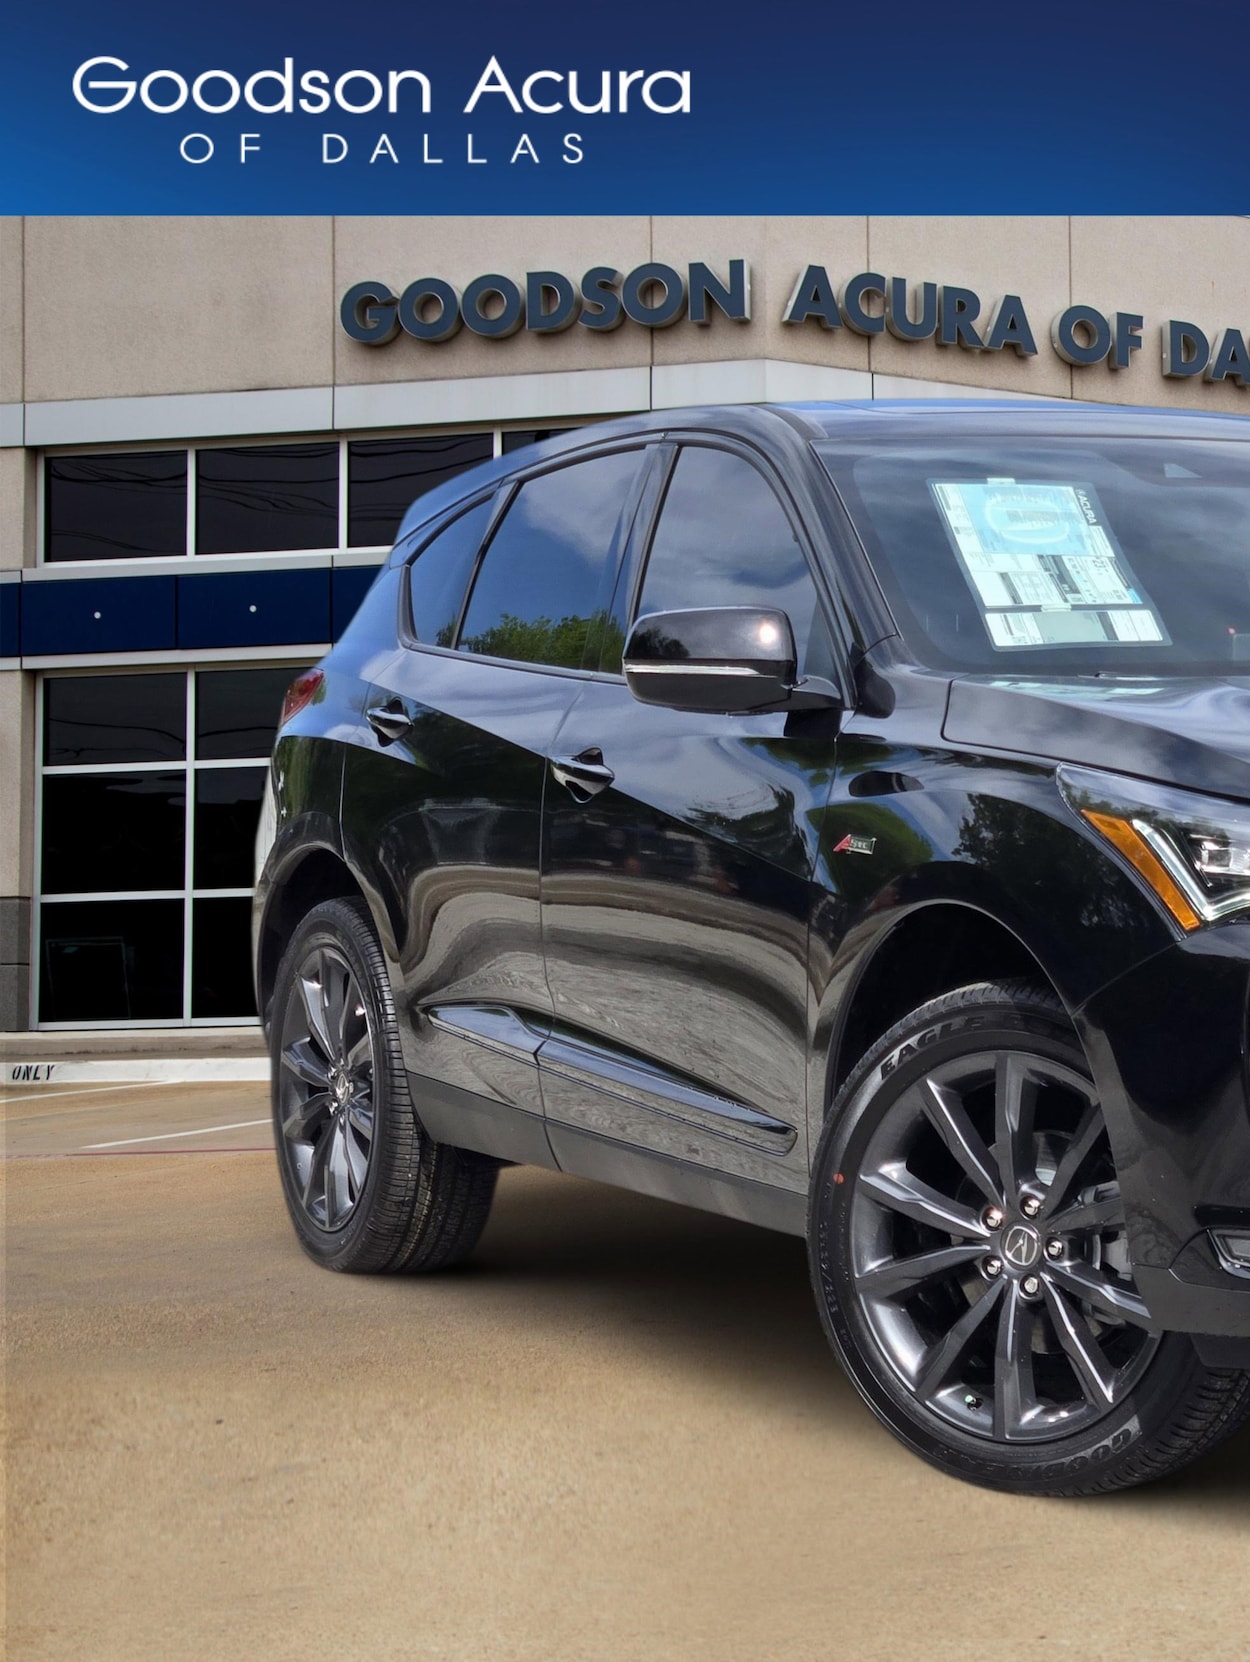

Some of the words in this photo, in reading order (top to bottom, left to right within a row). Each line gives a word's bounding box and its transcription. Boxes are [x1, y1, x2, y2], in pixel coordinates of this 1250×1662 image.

[340, 259, 751, 345] GOODSON
[782, 265, 1038, 356] ACURA
[1052, 305, 1144, 370] OF
[1077, 494, 1097, 524] ACURA
[11, 1064, 56, 1081] ONLY
